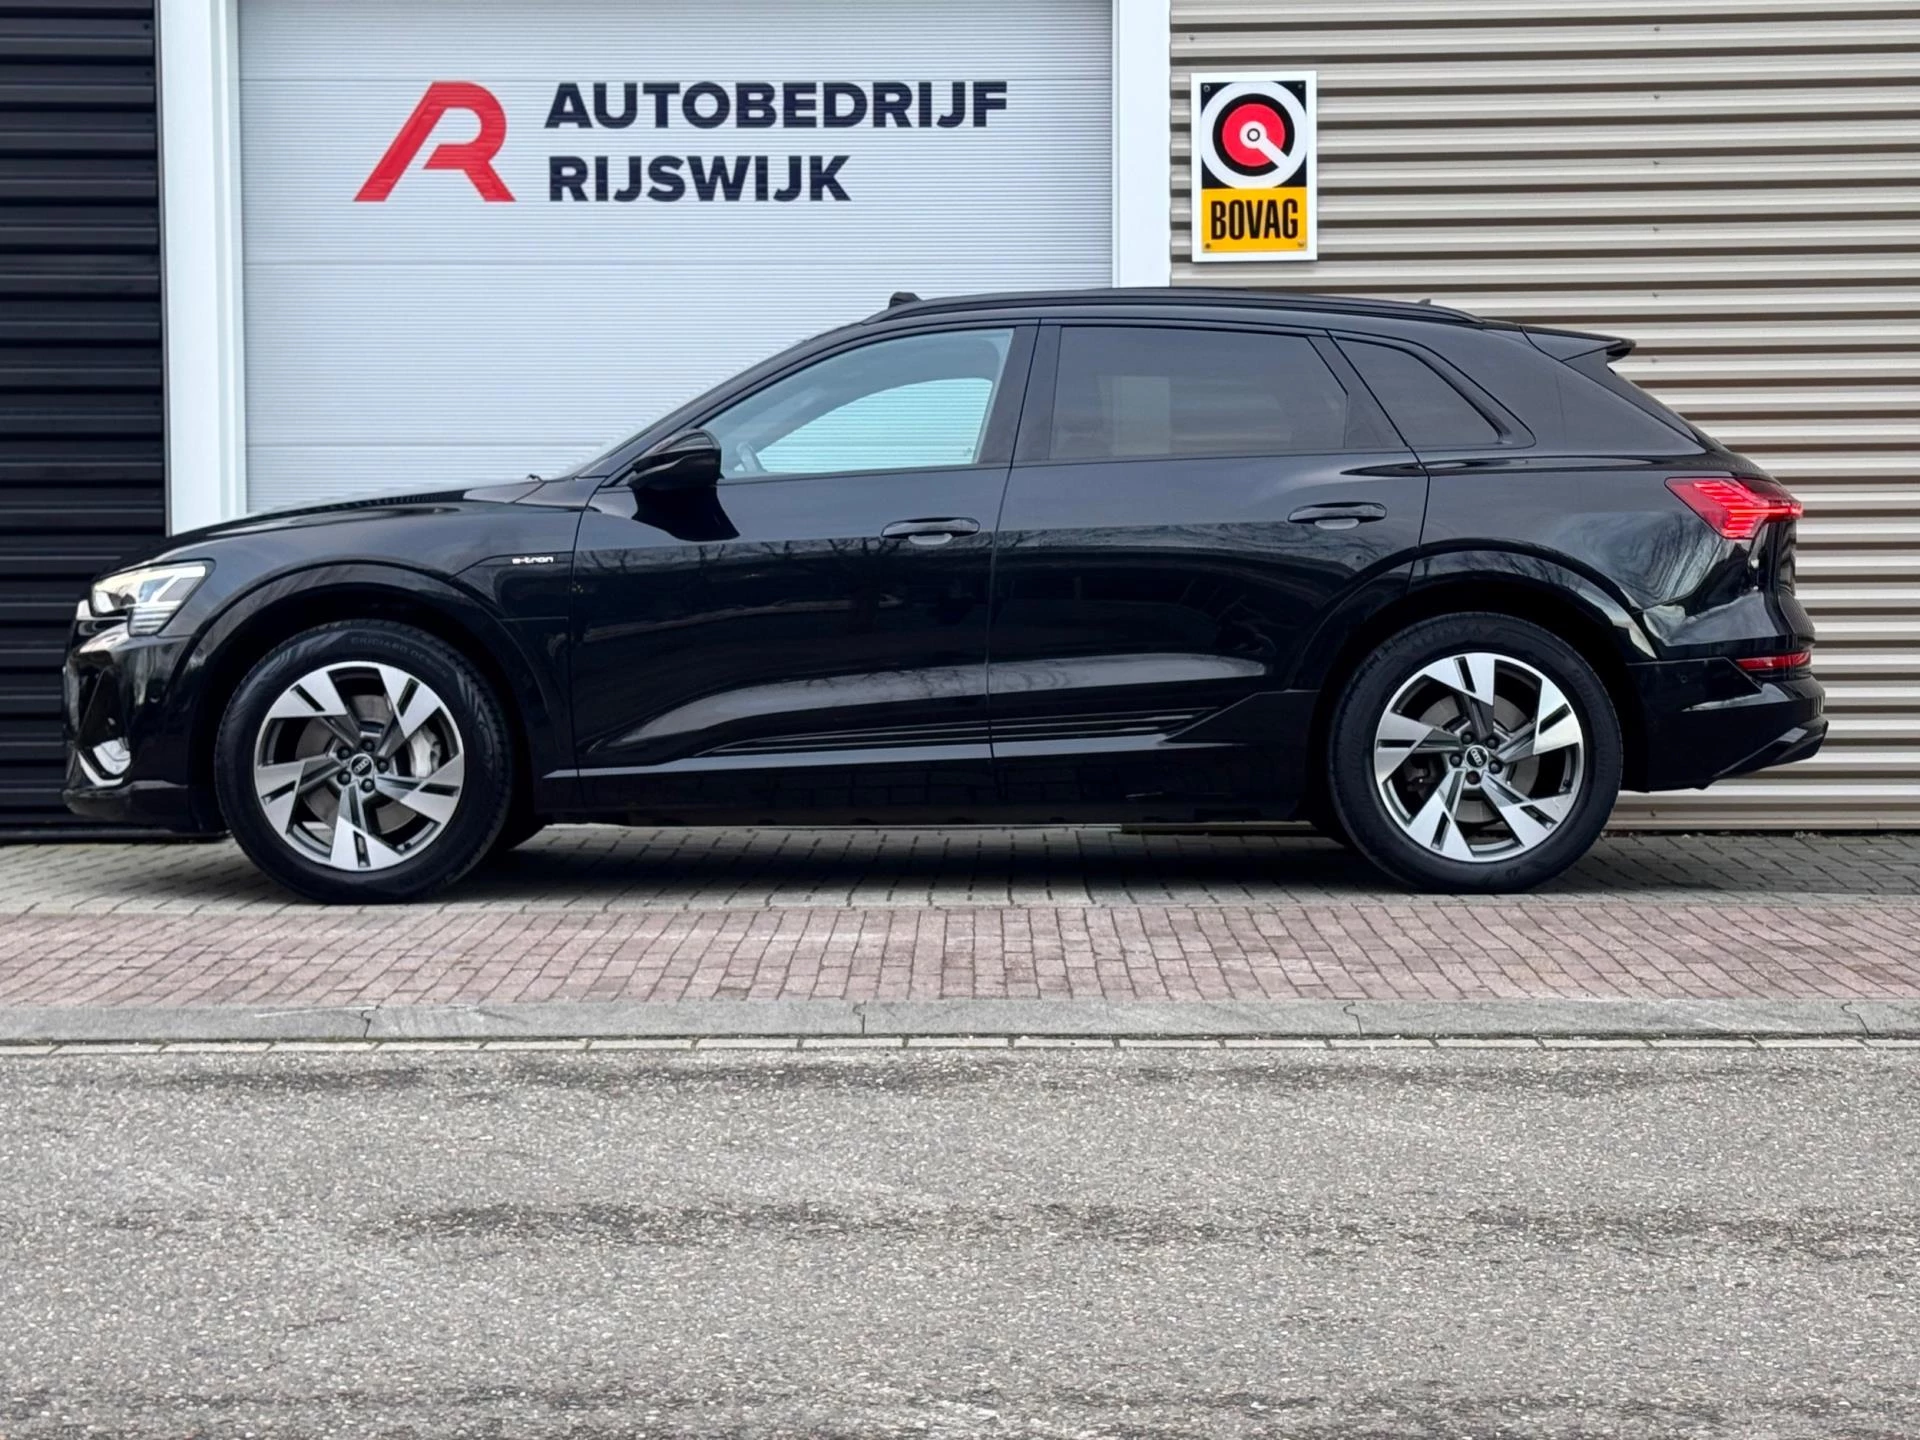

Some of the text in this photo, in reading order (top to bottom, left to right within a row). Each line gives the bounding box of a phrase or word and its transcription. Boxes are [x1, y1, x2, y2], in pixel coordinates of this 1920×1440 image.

[545, 81, 1008, 130] AUTOBEDRIJF
[549, 155, 850, 203] RIJSWIJK
[1210, 198, 1298, 241] BOVAG
[511, 556, 554, 566] e-tron
